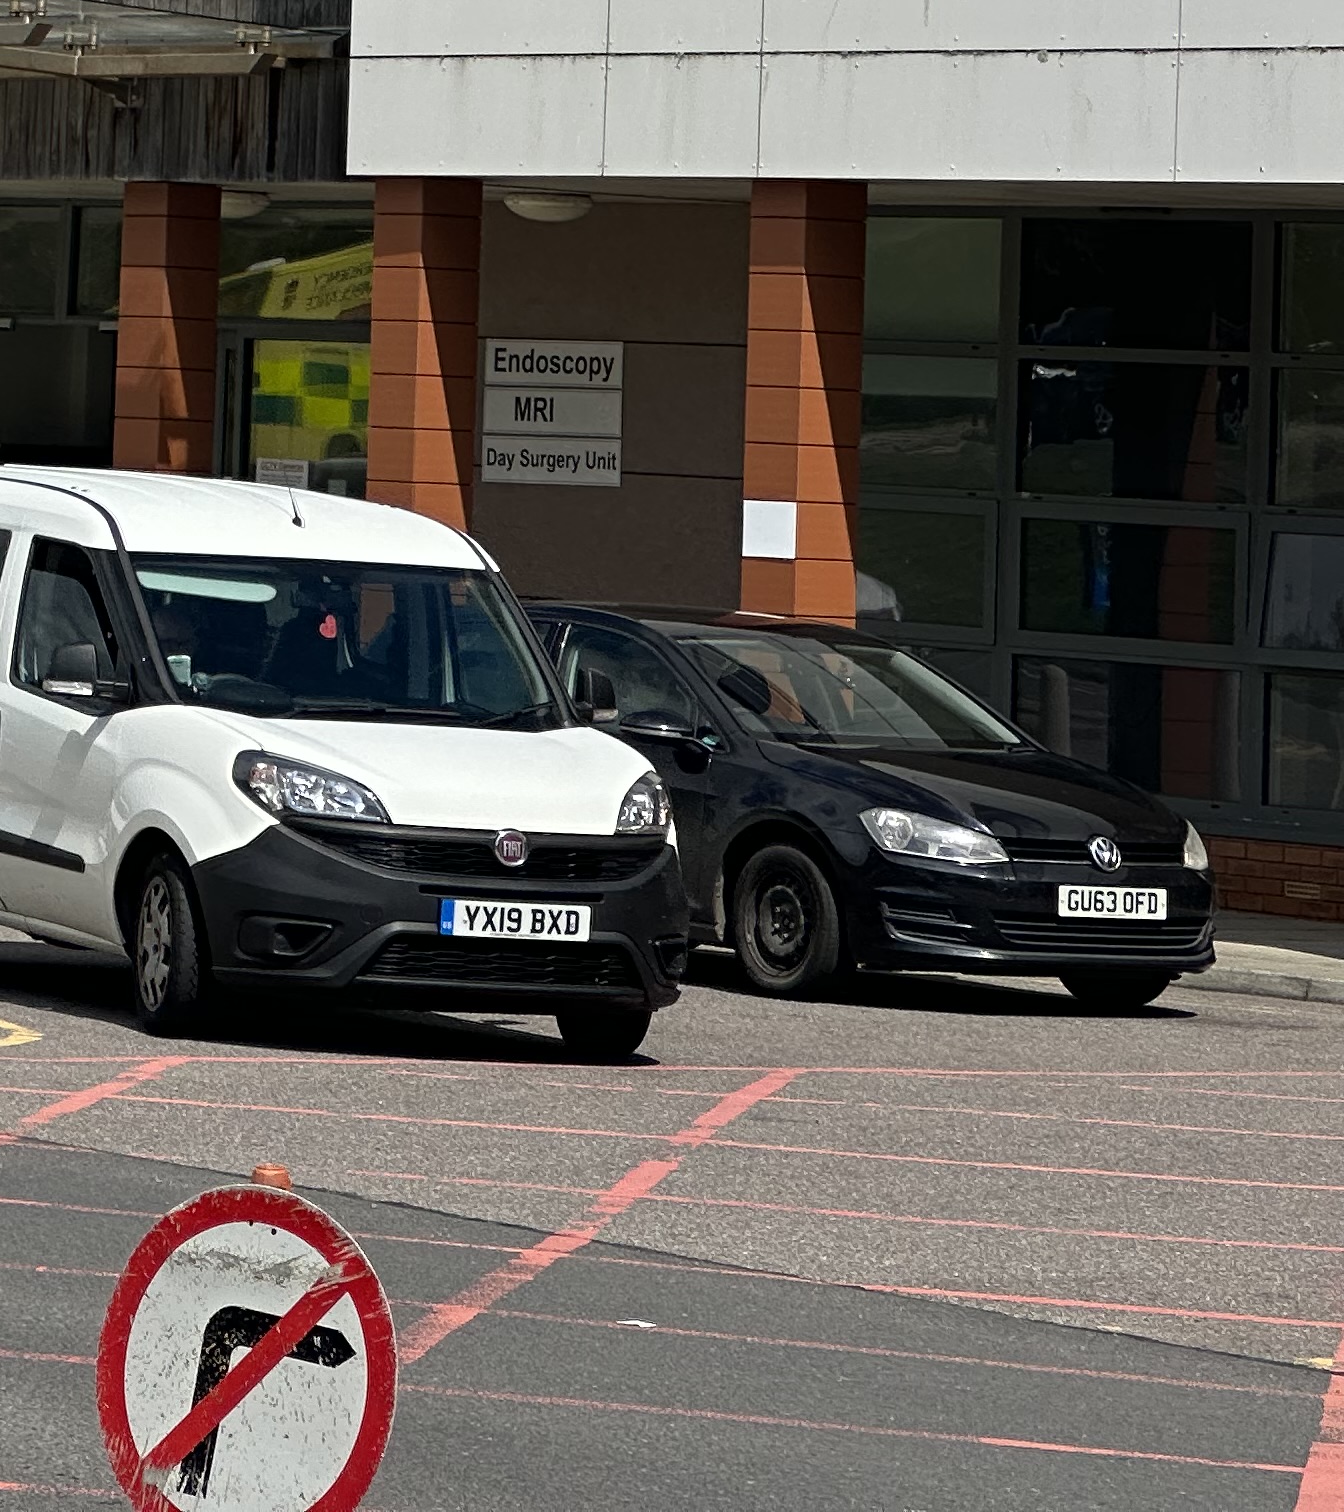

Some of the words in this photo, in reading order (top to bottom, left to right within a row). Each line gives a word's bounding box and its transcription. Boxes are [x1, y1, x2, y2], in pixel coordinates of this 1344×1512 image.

[493, 347, 615, 382] Endoscopy
[514, 396, 554, 422] MRI
[486, 447, 515, 471] Day
[520, 448, 581, 473] Surgery
[585, 450, 617, 471] Unit
[503, 841, 522, 857] FIAT
[1068, 889, 1117, 912] GU63
[1123, 891, 1158, 914] OFD
[465, 905, 522, 933] YX19
[530, 908, 580, 935] BXD
